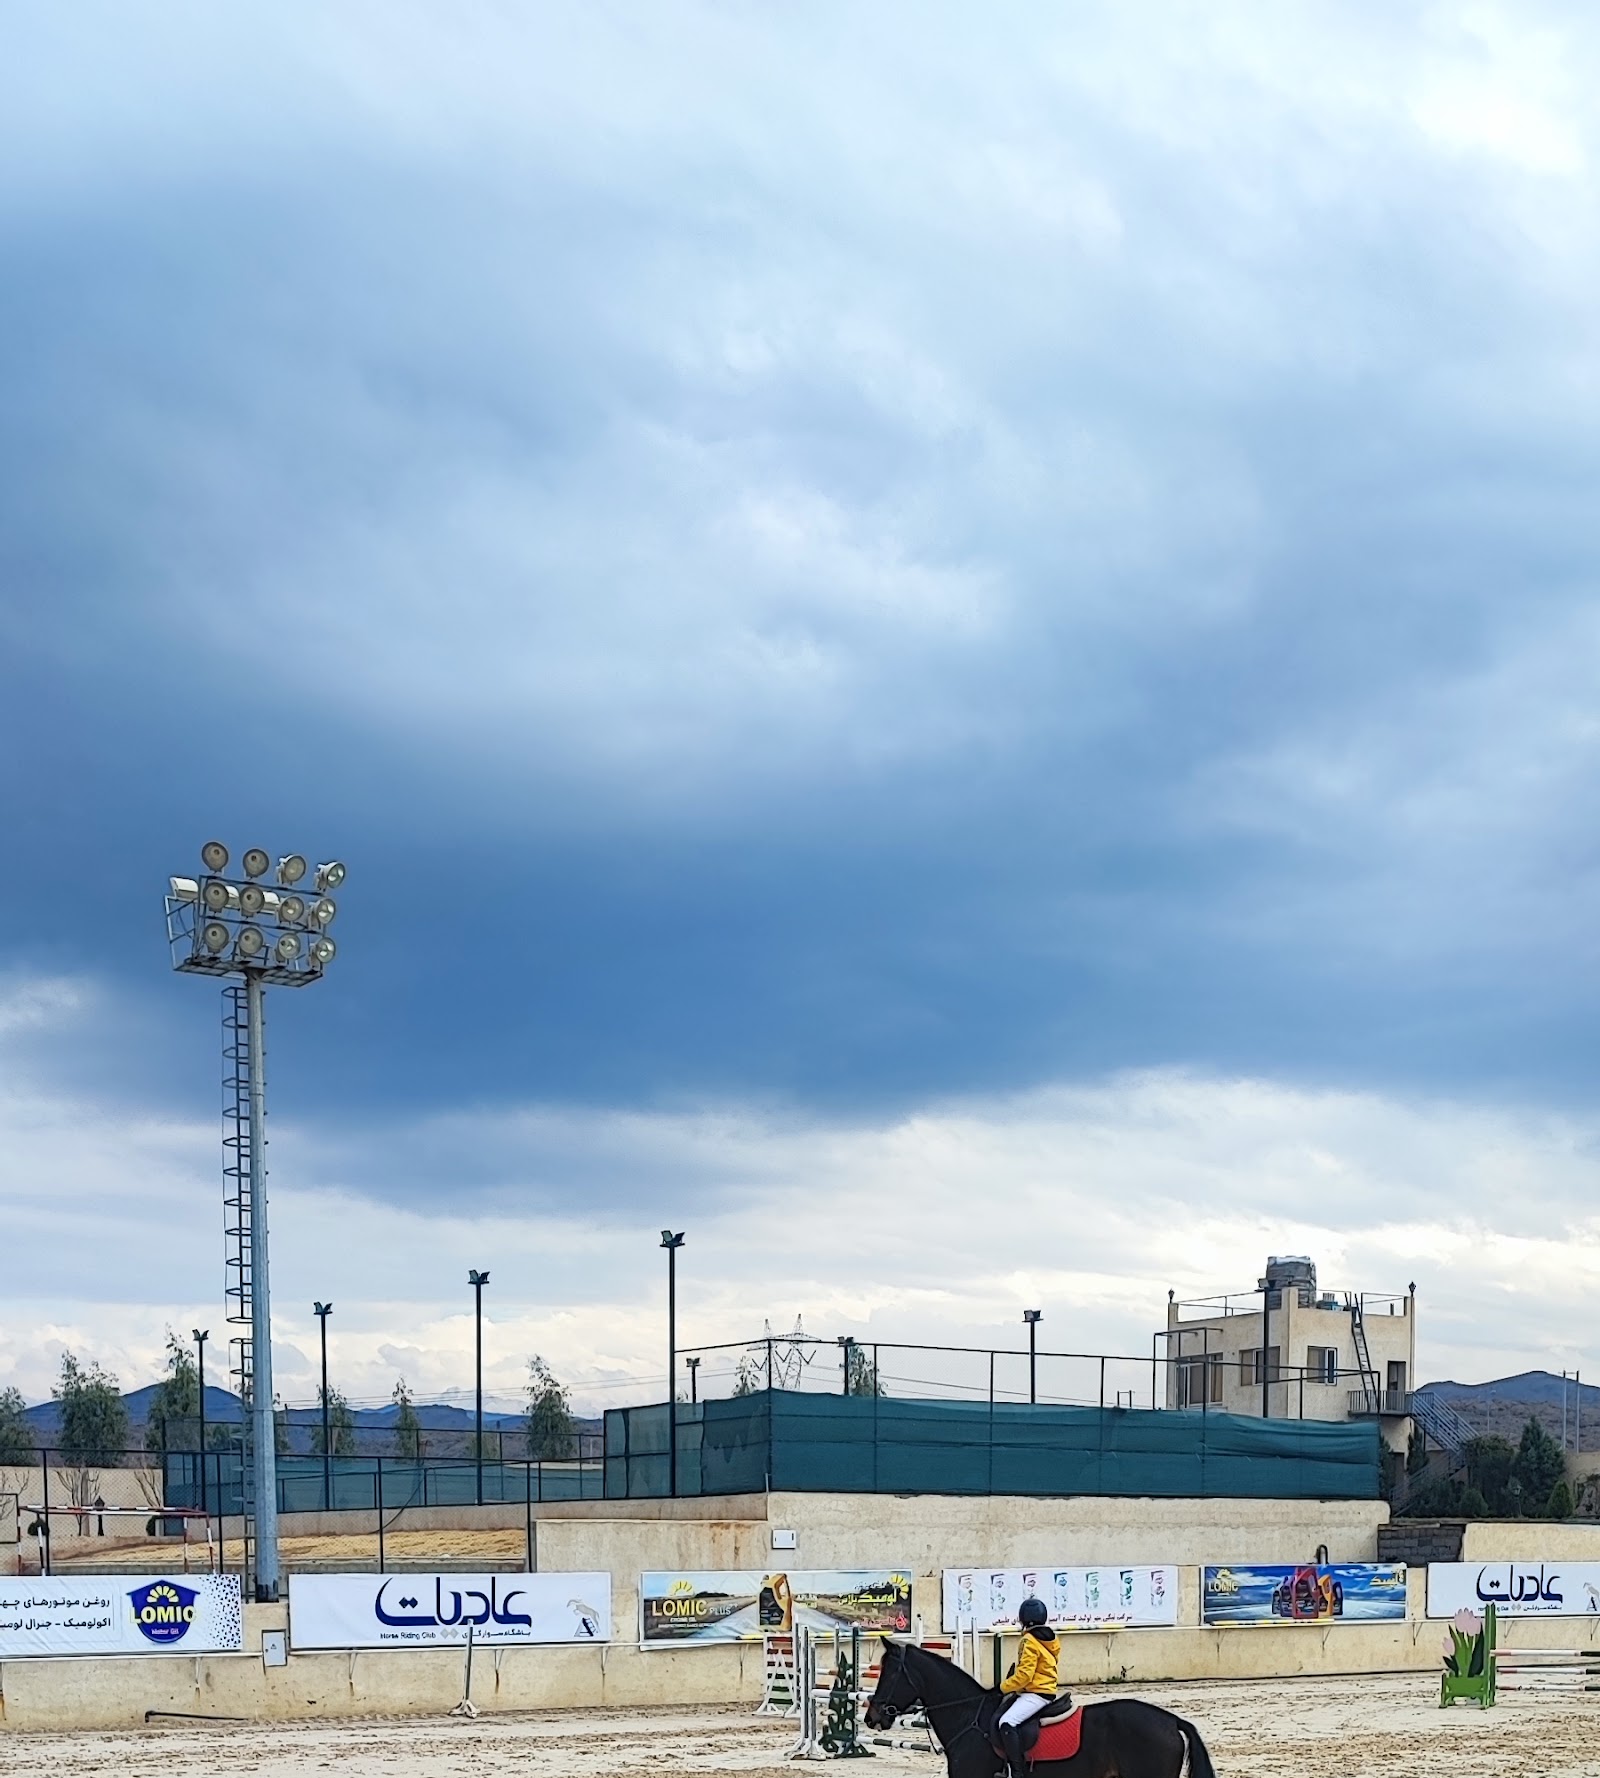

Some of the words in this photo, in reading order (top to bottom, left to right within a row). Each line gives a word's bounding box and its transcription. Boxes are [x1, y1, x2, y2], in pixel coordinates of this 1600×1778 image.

[0, 1599, 20, 1610] چه
[23, 1596, 80, 1609] موتورهای
[82, 1596, 110, 1608] روغن
[652, 1599, 707, 1617] LOMIC
[709, 1606, 731, 1616] PLUS
[130, 1605, 197, 1624] LOMIC
[0, 1618, 22, 1631] لومی
[25, 1618, 52, 1630] جنرال
[63, 1617, 111, 1630] اکولومیک
